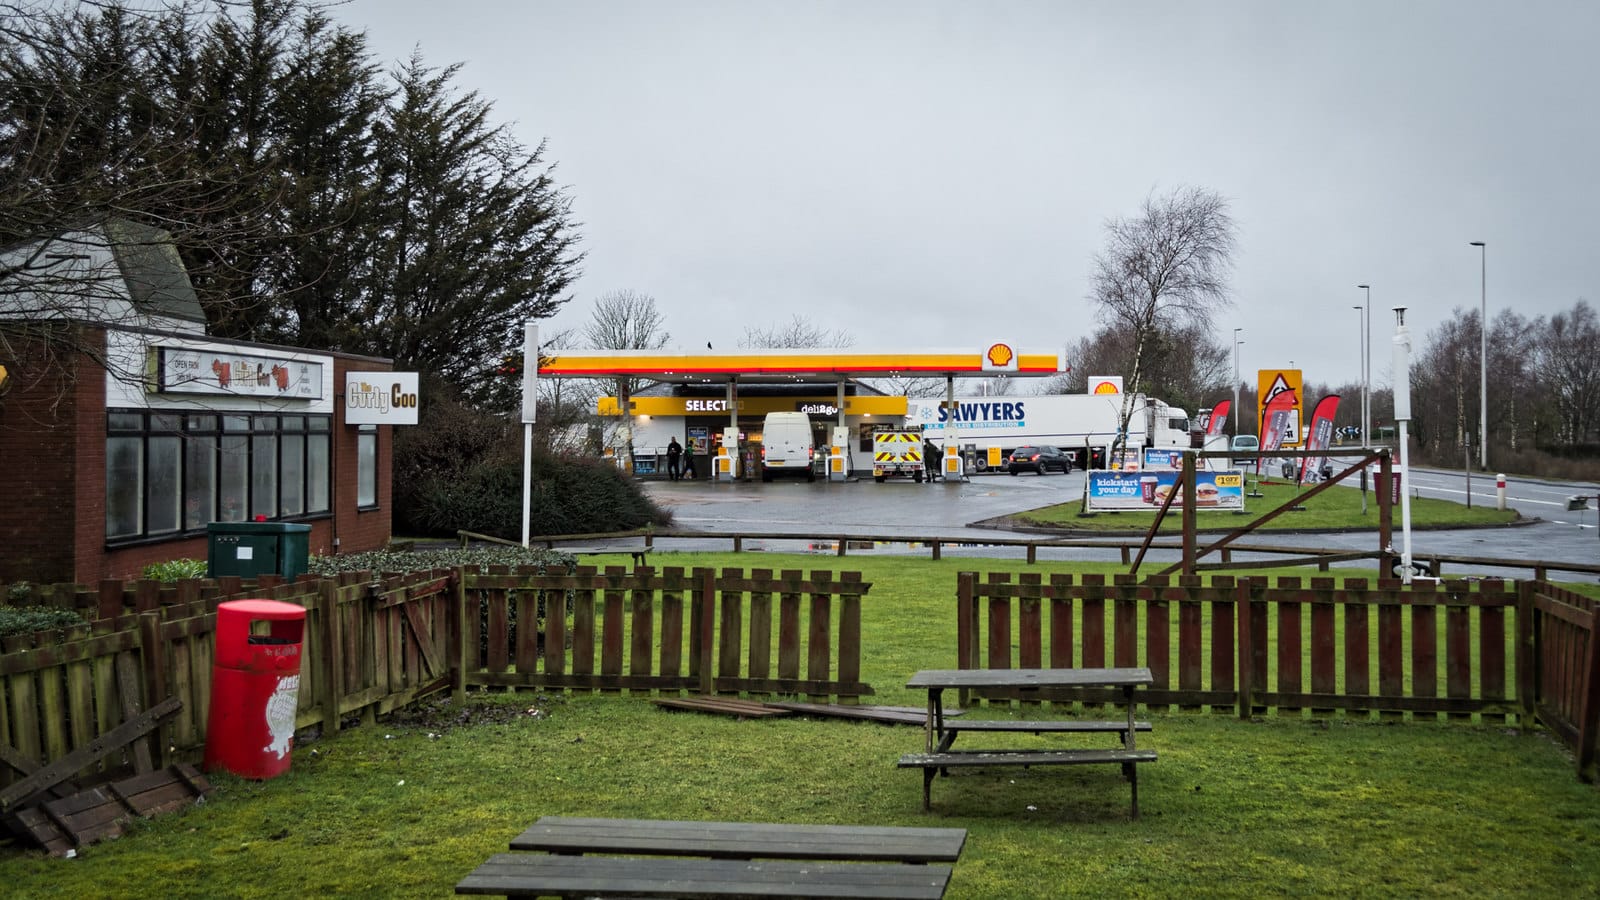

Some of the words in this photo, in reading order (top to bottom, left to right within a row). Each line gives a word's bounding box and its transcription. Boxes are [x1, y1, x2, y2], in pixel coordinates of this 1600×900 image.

[348, 382, 389, 414] Curly
[392, 383, 416, 408] Coo
[686, 400, 727, 411] SELECT
[801, 404, 838, 415] deli2go
[938, 402, 1025, 422] SAWYERS
[1098, 487, 1119, 495] your
[1120, 486, 1137, 495] day
